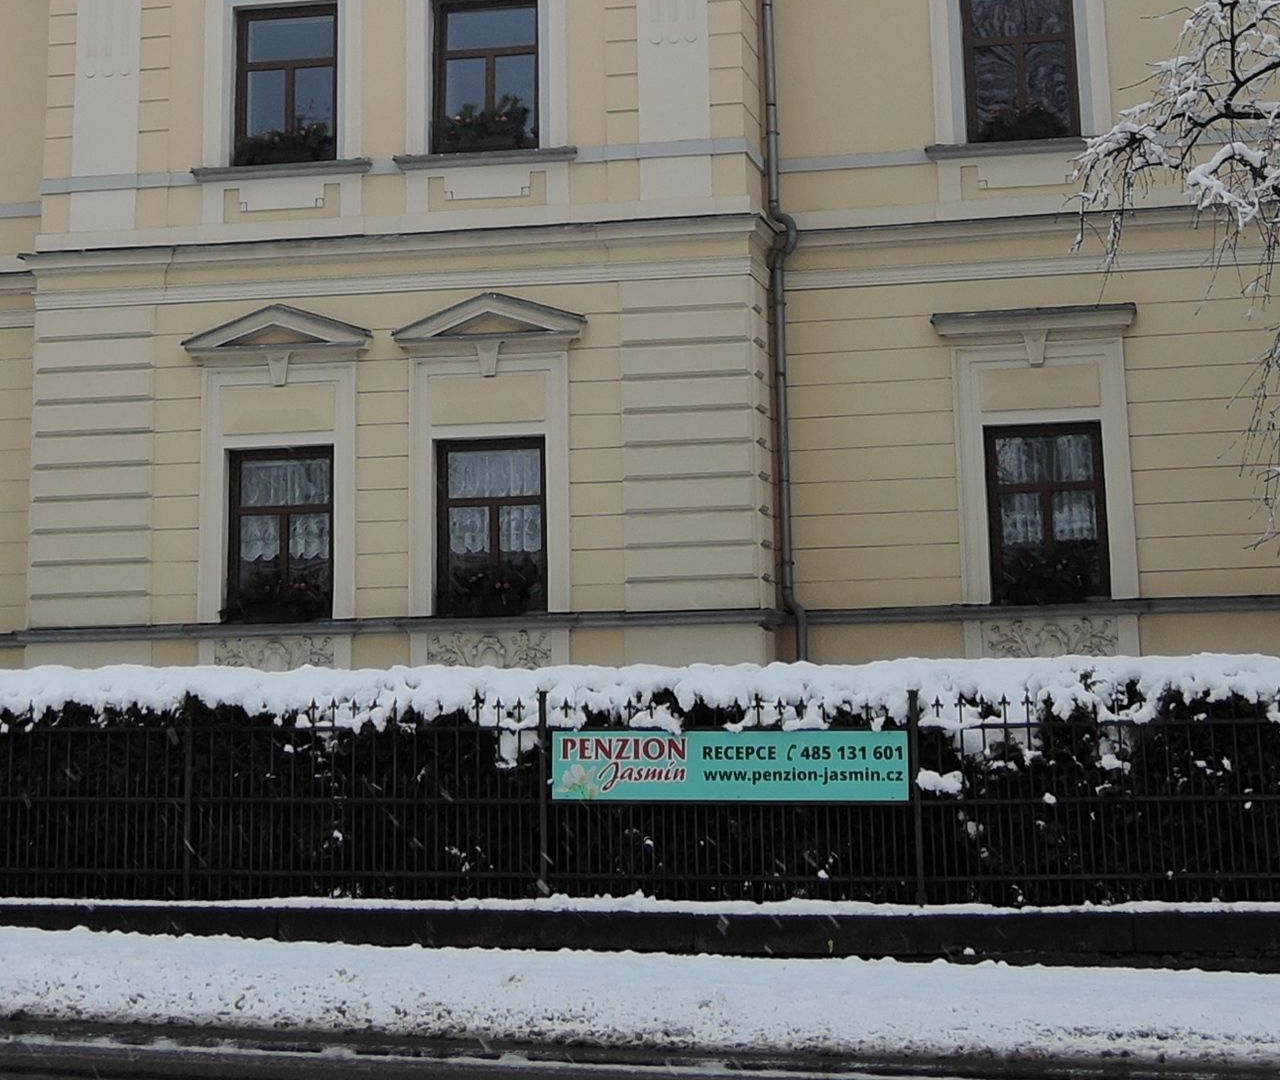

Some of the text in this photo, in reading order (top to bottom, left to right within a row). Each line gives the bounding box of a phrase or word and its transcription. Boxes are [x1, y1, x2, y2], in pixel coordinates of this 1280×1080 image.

[561, 737, 687, 761] PENZION
[702, 746, 904, 760] RECEPCE 485 131 601
[598, 761, 686, 792] Jasmín
[703, 767, 904, 785] www.penzion-jasmin.cz
